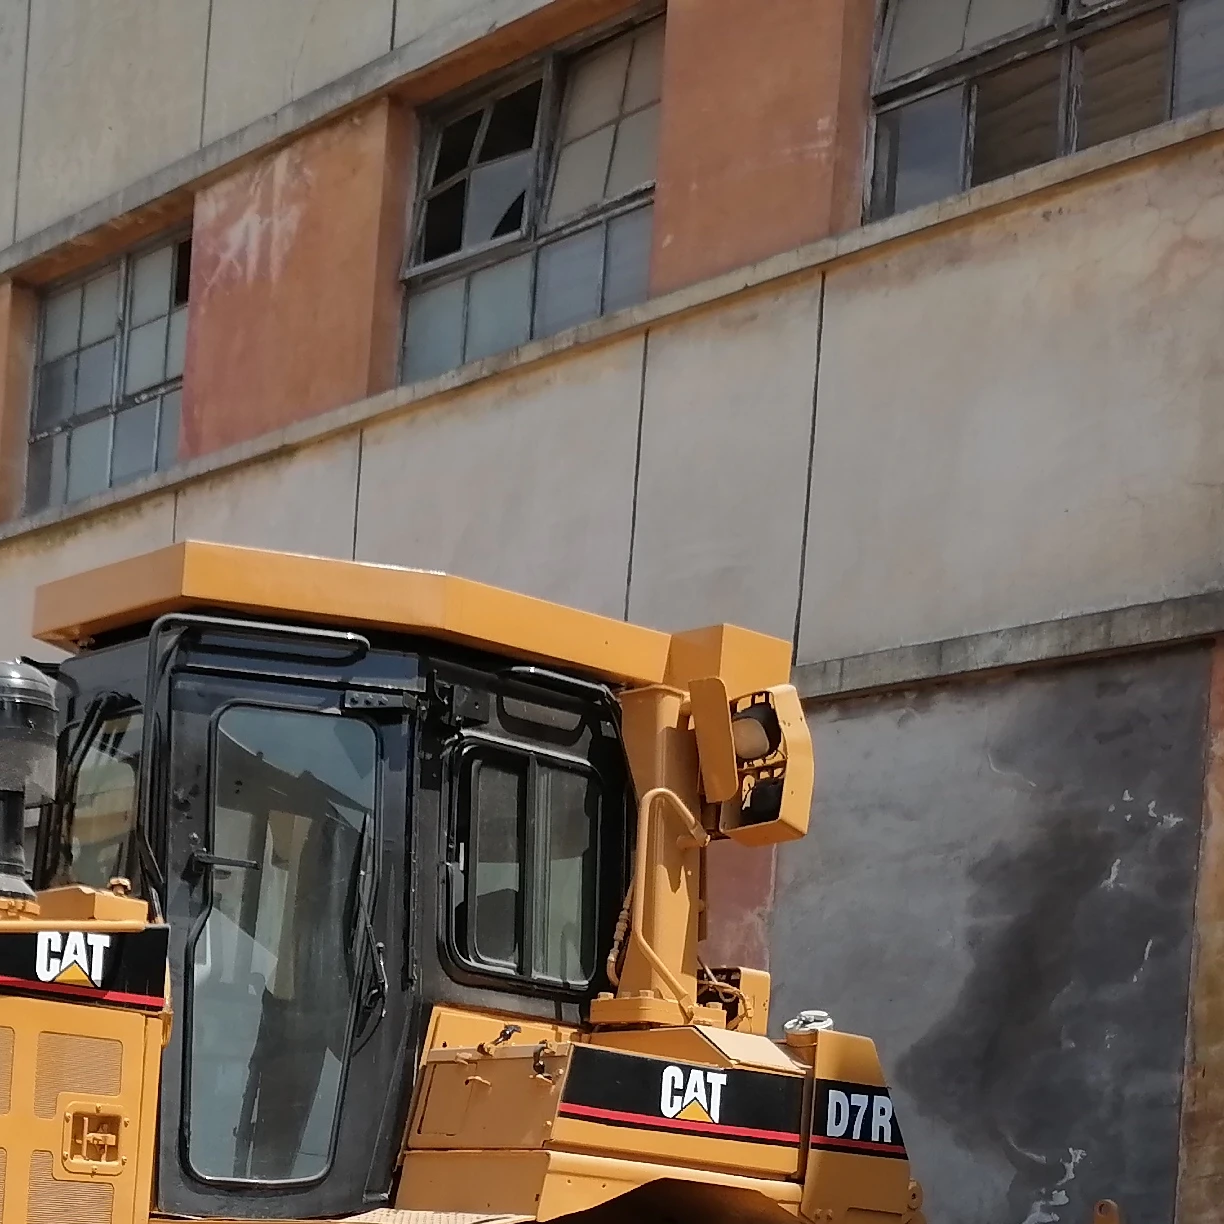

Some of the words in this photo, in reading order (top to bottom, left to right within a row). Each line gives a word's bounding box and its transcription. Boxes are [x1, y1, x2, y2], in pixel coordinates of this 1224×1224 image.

[36, 931, 111, 988] CAT
[660, 1065, 727, 1124] CAT
[826, 1089, 893, 1143] D7R
